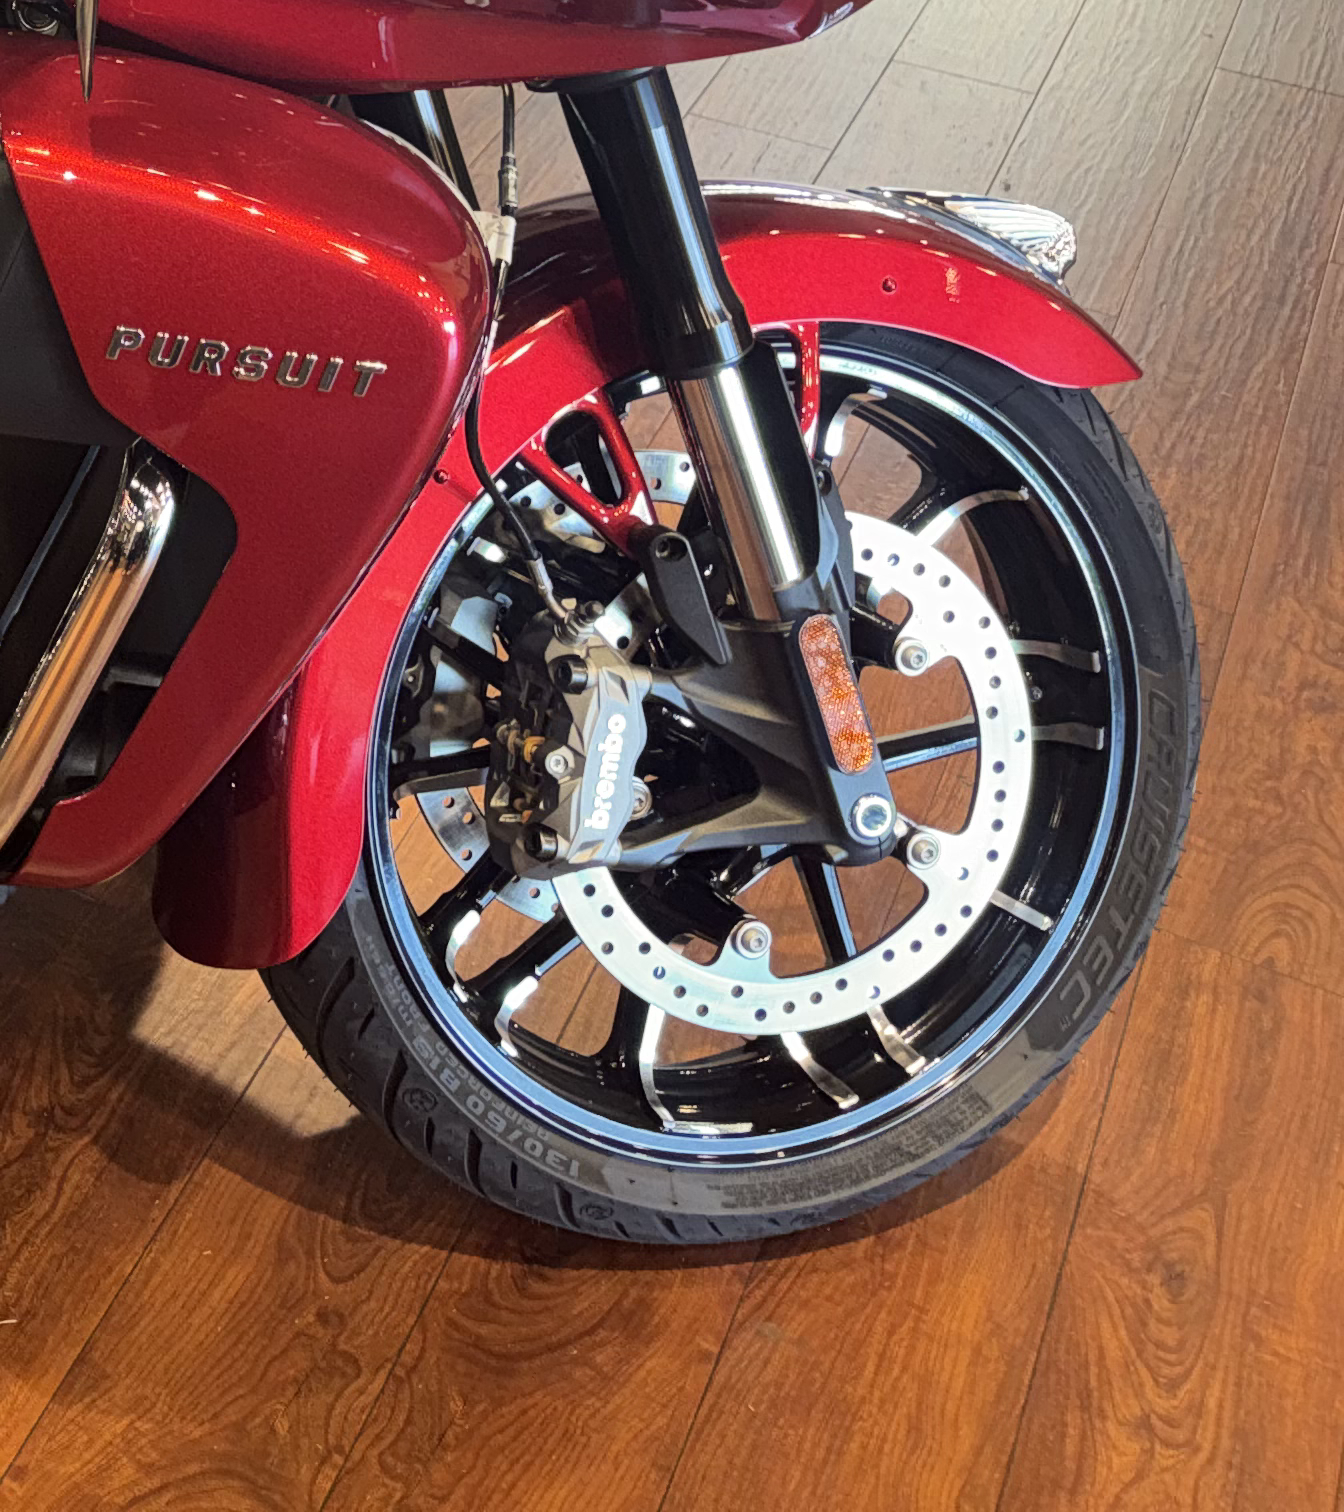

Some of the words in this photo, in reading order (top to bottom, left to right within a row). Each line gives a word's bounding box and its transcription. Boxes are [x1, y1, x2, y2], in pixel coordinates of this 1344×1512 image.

[105, 325, 388, 397] PURSUIT
[584, 713, 628, 830] brembo
[1060, 690, 1178, 1020] CRUISETEC
[465, 1094, 581, 1178] 130/60
